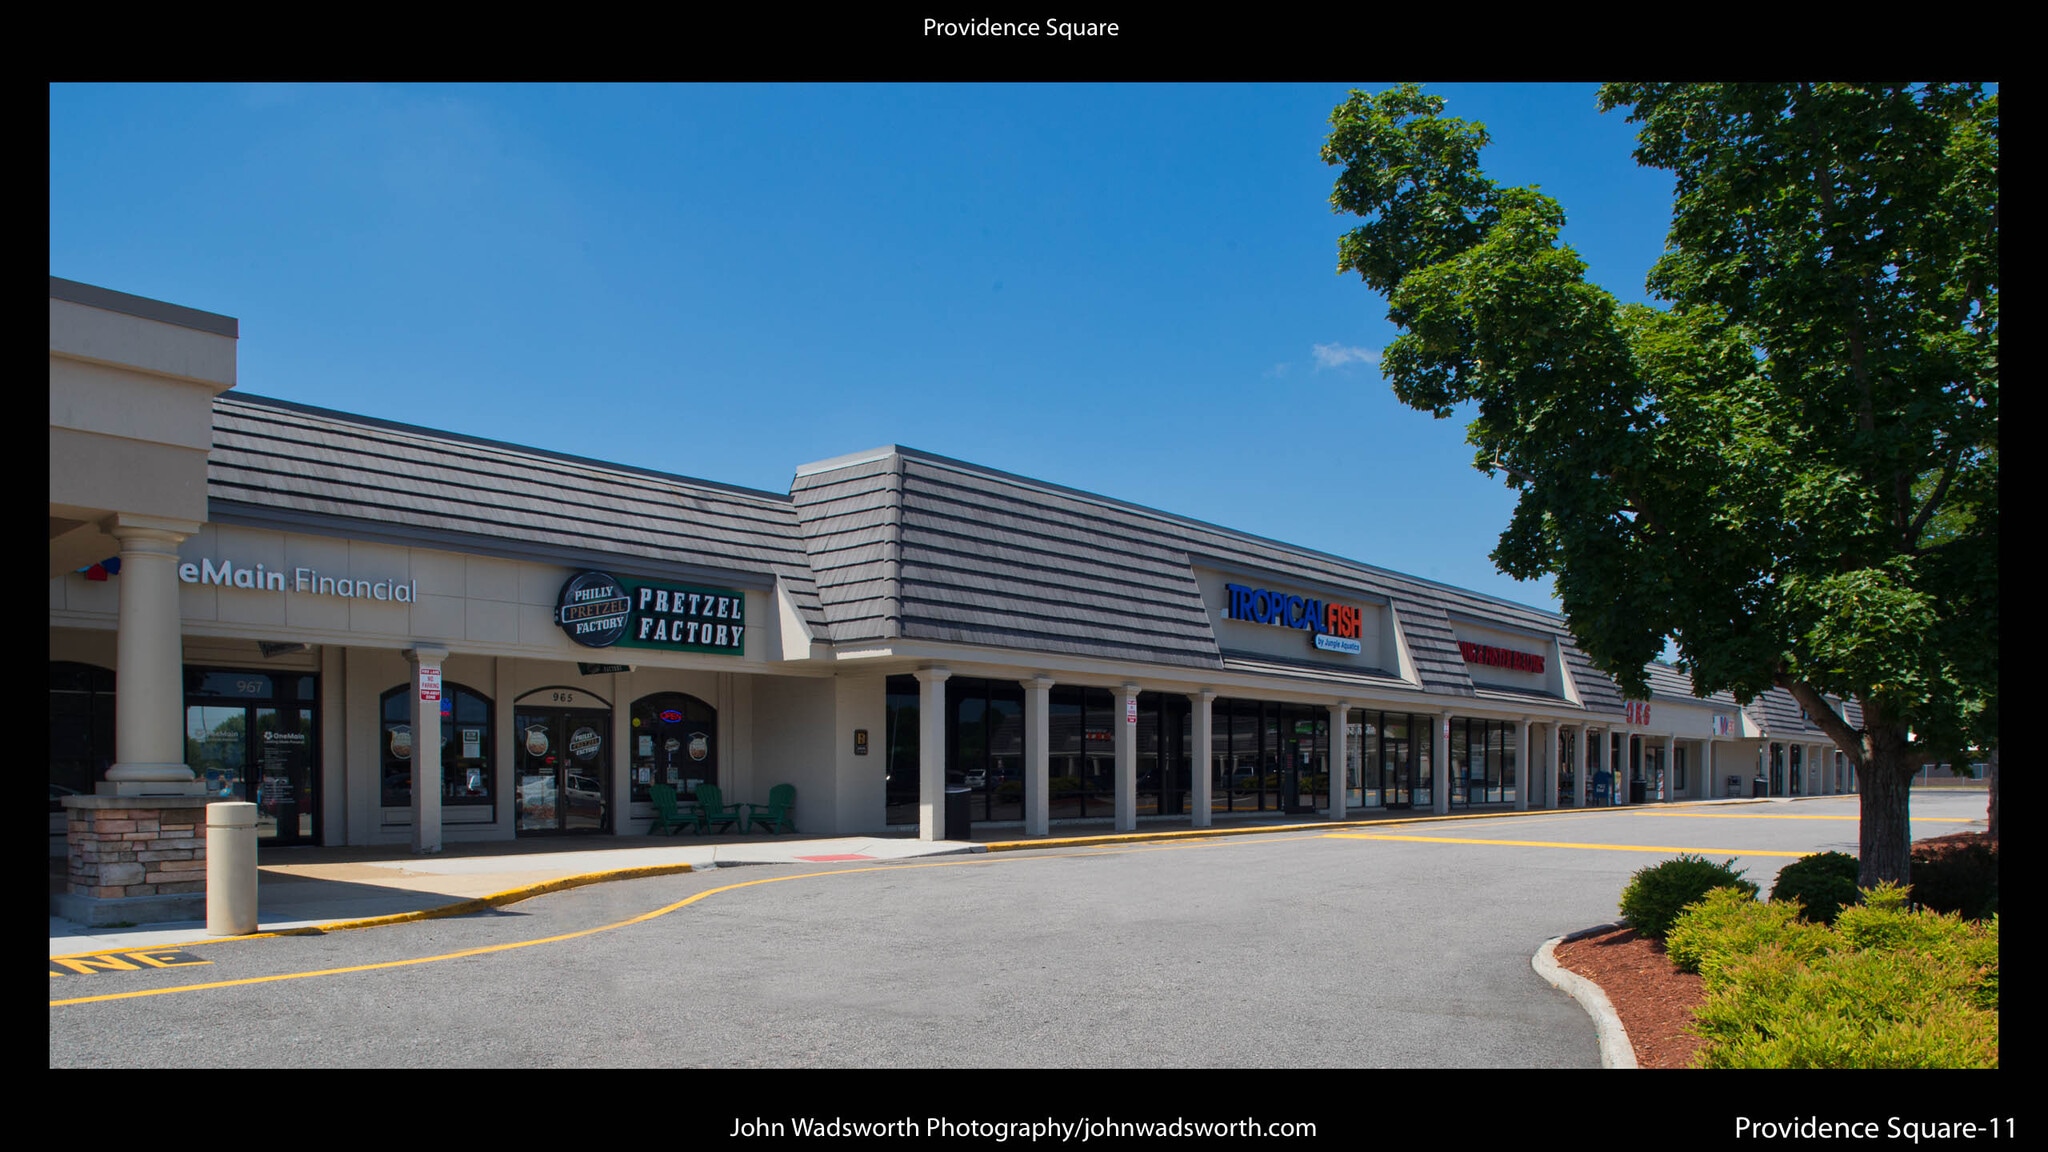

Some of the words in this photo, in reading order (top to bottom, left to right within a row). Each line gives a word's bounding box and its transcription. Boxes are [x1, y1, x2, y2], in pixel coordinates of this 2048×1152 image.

[179, 558, 285, 592] eMain
[295, 567, 417, 604] Financial
[575, 586, 614, 601] PHILLY
[569, 600, 626, 619] PRETZEL
[639, 588, 741, 619] PRETZEL
[1226, 583, 1328, 633] TROPICAL
[1328, 602, 1363, 639] FISH
[576, 616, 625, 635] FACTORY
[639, 617, 743, 647] FACTORY
[1317, 638, 1324, 646] by
[1325, 638, 1341, 649] Jungle
[236, 681, 263, 693] 967
[552, 692, 573, 702] 965
[50, 949, 215, 977] NE
